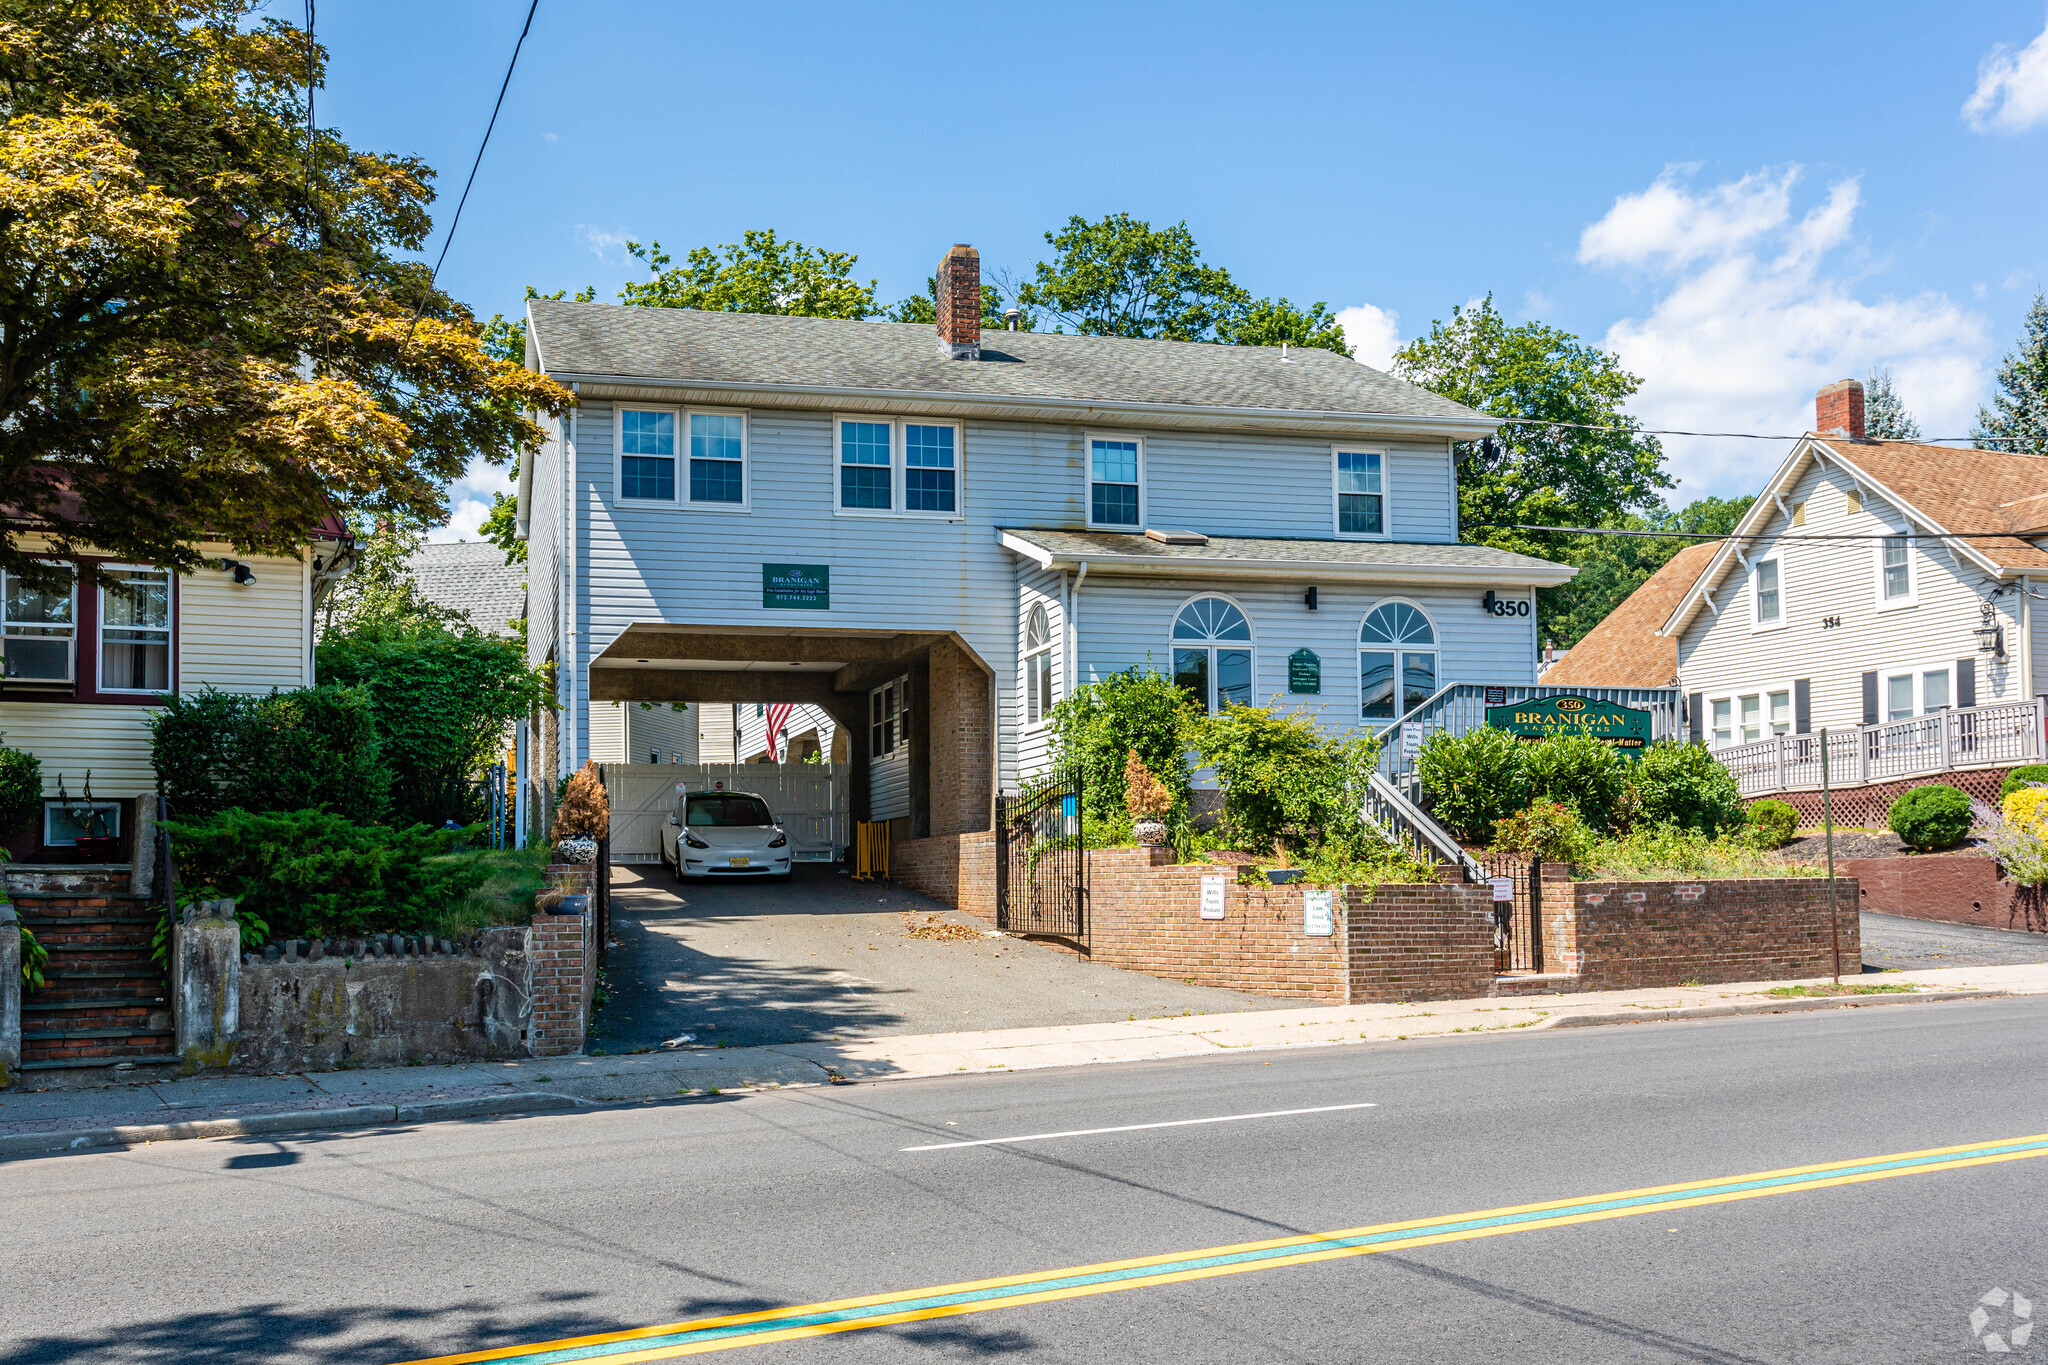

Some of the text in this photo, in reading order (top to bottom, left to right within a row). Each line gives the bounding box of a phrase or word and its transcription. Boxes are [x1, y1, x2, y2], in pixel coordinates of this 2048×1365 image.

[772, 576, 820, 584] BRANIGAN
[1494, 600, 1530, 617] 350
[1822, 615, 1841, 630] 354
[1561, 700, 1581, 709] 350
[1514, 711, 1626, 726] BRANIGAN
[1618, 737, 1642, 747] Matter
